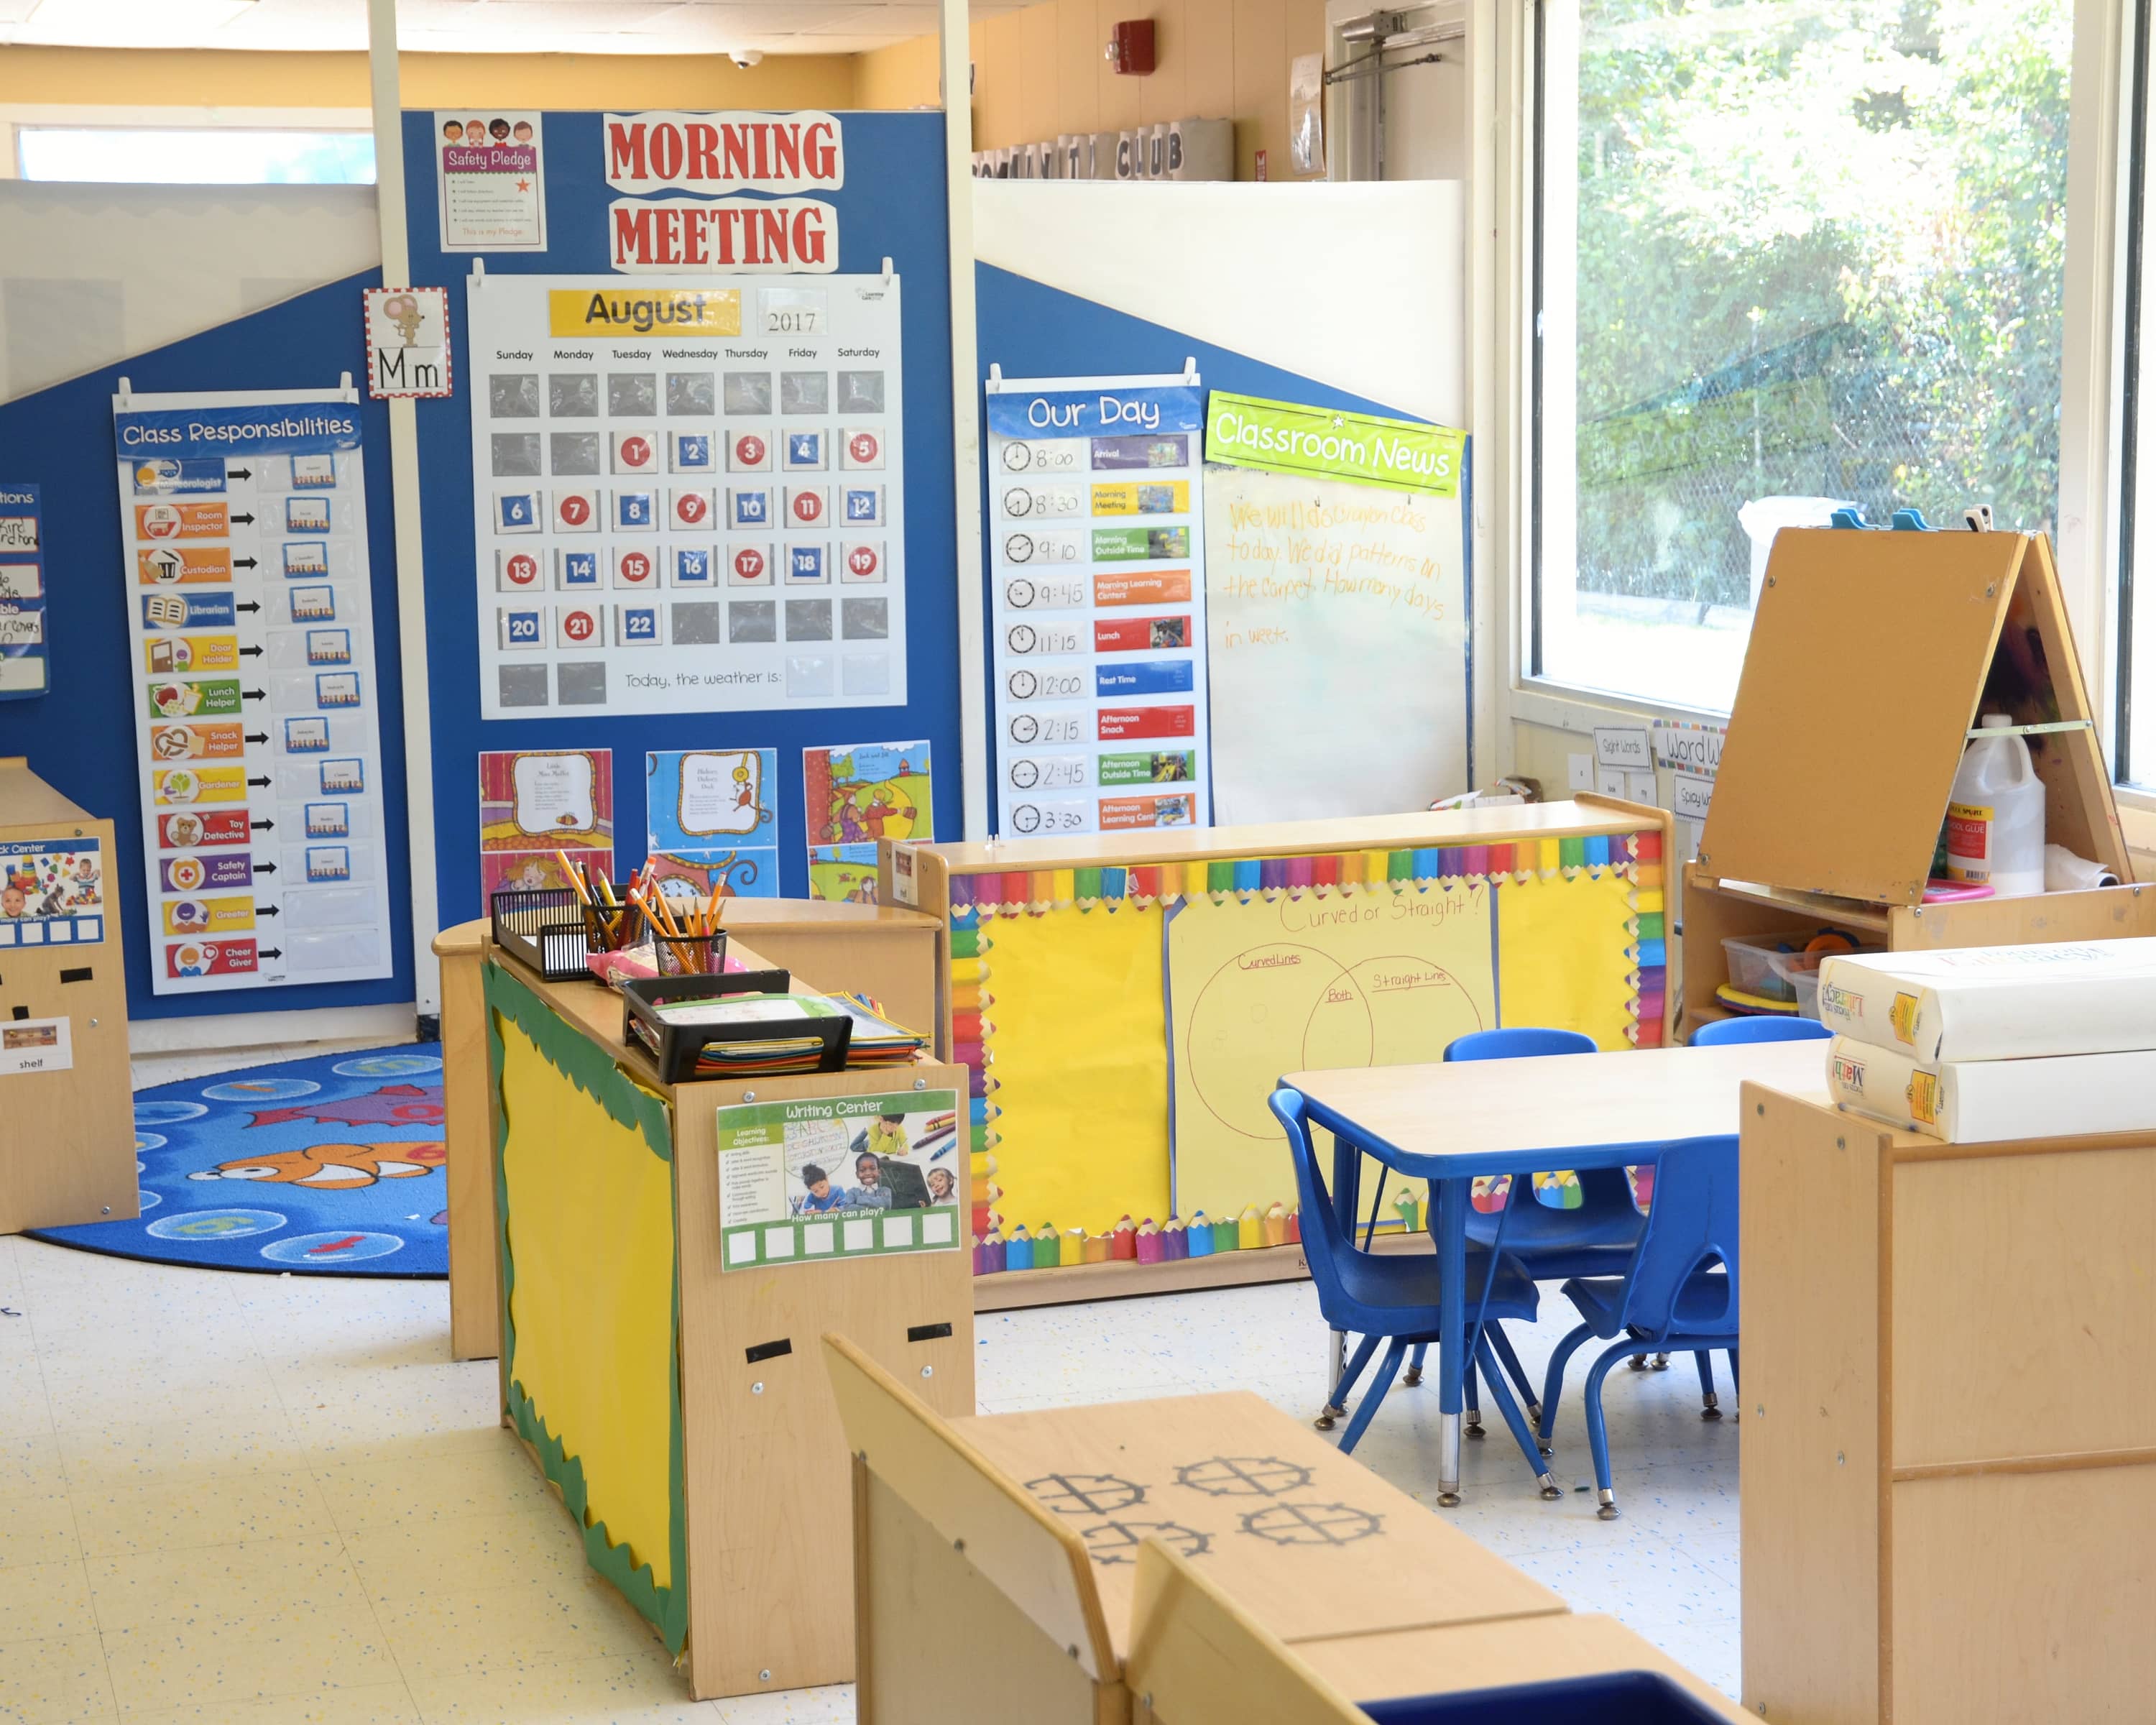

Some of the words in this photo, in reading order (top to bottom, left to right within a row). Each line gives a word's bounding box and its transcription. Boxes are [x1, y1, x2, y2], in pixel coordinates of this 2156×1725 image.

[609, 121, 837, 181] MORNING
[448, 151, 487, 170] Safety
[491, 151, 531, 170] Pledge
[614, 206, 826, 265] MEETING
[586, 293, 707, 331] August
[768, 313, 817, 332] 2017
[496, 350, 533, 361] Sunday
[553, 350, 594, 361] Monday
[612, 349, 652, 360] Tuesday
[662, 349, 718, 360] Wednesday
[724, 349, 768, 359] Thursday
[788, 349, 817, 359] Friday
[837, 348, 880, 358] Saturday
[1028, 398, 1087, 428] Our
[1099, 396, 1160, 429] Day
[123, 424, 181, 446] Class
[188, 417, 354, 444] Responsibilities
[632, 446, 639, 459] 1
[688, 445, 699, 459] 2
[745, 444, 755, 458] 3
[798, 443, 809, 457] 4
[860, 442, 869, 456] 5
[1217, 412, 1365, 466] Classroom
[1372, 436, 1451, 478] News
[1036, 449, 1073, 467] 8:00
[1094, 448, 1120, 459] Arrival
[1095, 490, 1127, 500] Morning
[511, 505, 522, 519] 6
[570, 504, 580, 518] 7
[629, 505, 640, 519] 8
[686, 502, 697, 517] 9
[742, 502, 760, 516] 10
[801, 500, 814, 514] 11
[853, 499, 870, 513] 12
[1036, 495, 1078, 514] 8:30
[1095, 500, 1126, 510] Meeting
[197, 511, 222, 520] Room
[1230, 503, 1262, 531] We
[1267, 502, 1304, 530] will
[183, 521, 224, 533] Inspector
[1095, 535, 1127, 545] Morning
[1039, 541, 1076, 559] 9:10
[1095, 545, 1125, 554] Outside
[1127, 544, 1145, 553] Time
[1289, 536, 1312, 564] We
[1314, 540, 1342, 565] did
[1348, 542, 1416, 573] patterns
[1420, 557, 1442, 582] on
[181, 565, 226, 575] Custodian
[513, 563, 531, 577] 13
[571, 562, 591, 576] 14
[627, 561, 644, 575] 15
[683, 559, 701, 574] 16
[742, 558, 758, 572] 17
[797, 556, 814, 570] 18
[854, 555, 871, 569] 19
[1097, 580, 1128, 590] Morning
[1130, 578, 1162, 589] Learning
[1041, 584, 1083, 604] 9:45
[1097, 591, 1127, 600] Centers
[1224, 576, 1256, 599] the
[1404, 583, 1444, 620] days
[190, 605, 229, 615] Librarian
[512, 621, 535, 635] 20
[570, 620, 588, 634] 21
[630, 617, 650, 632] 22
[1097, 632, 1120, 640] Lunch
[1225, 621, 1242, 649] in
[210, 644, 232, 653] Door
[1041, 633, 1076, 653] 11:15
[203, 654, 233, 665] Holder
[625, 673, 671, 689] Today,
[676, 673, 699, 686] the
[704, 673, 760, 685] weather
[765, 672, 781, 684] is:
[1040, 675, 1082, 696] 12:00
[1100, 676, 1117, 685] Rest
[1118, 675, 1136, 684] Time
[208, 687, 235, 697] Lunch
[206, 697, 236, 709] Helper
[1101, 714, 1139, 724] Afternoon
[1044, 719, 1079, 741] 2:15
[1101, 725, 1124, 734] Snack
[211, 731, 238, 741] Snack
[208, 742, 239, 753] Helper
[1603, 739, 1619, 754] Sight
[1621, 740, 1641, 754] Words
[1667, 733, 1705, 762] Word
[1102, 760, 1140, 768] Afternoon
[1044, 763, 1084, 786] 2:45
[1102, 770, 1130, 779] Outside
[1132, 769, 1150, 778] Time
[198, 780, 240, 790] Gardener
[1641, 788, 1647, 798] my
[1681, 788, 1701, 807] Spicy
[1102, 804, 1140, 813] Afternoon
[229, 819, 244, 831] Toy
[1045, 811, 1082, 829] 3:30
[1102, 814, 1135, 824] Learning
[1966, 824, 1984, 833] GLUE
[203, 830, 244, 840] Detective
[12, 843, 45, 853] Center
[217, 862, 245, 873] Safety
[211, 870, 246, 882] Captain
[216, 909, 249, 919] Greeter
[1280, 895, 1357, 932] Curved
[1364, 904, 1380, 921] or
[225, 948, 252, 957] Cheer
[229, 958, 252, 967] Giver
[1238, 953, 1276, 968] Curved
[1277, 952, 1302, 965] Lines
[1373, 972, 1421, 989] Straight
[1424, 971, 1447, 983] Lines
[1327, 989, 1353, 1001] Both
[19, 1059, 43, 1069] shelf
[1833, 1060, 1864, 1087] Math!
[786, 1105, 833, 1119] Writing
[836, 1100, 883, 1115] Center
[737, 1128, 766, 1137] Learning
[733, 1136, 770, 1146] Objectives:
[815, 1212, 839, 1222] many
[860, 1208, 884, 1219] play?
